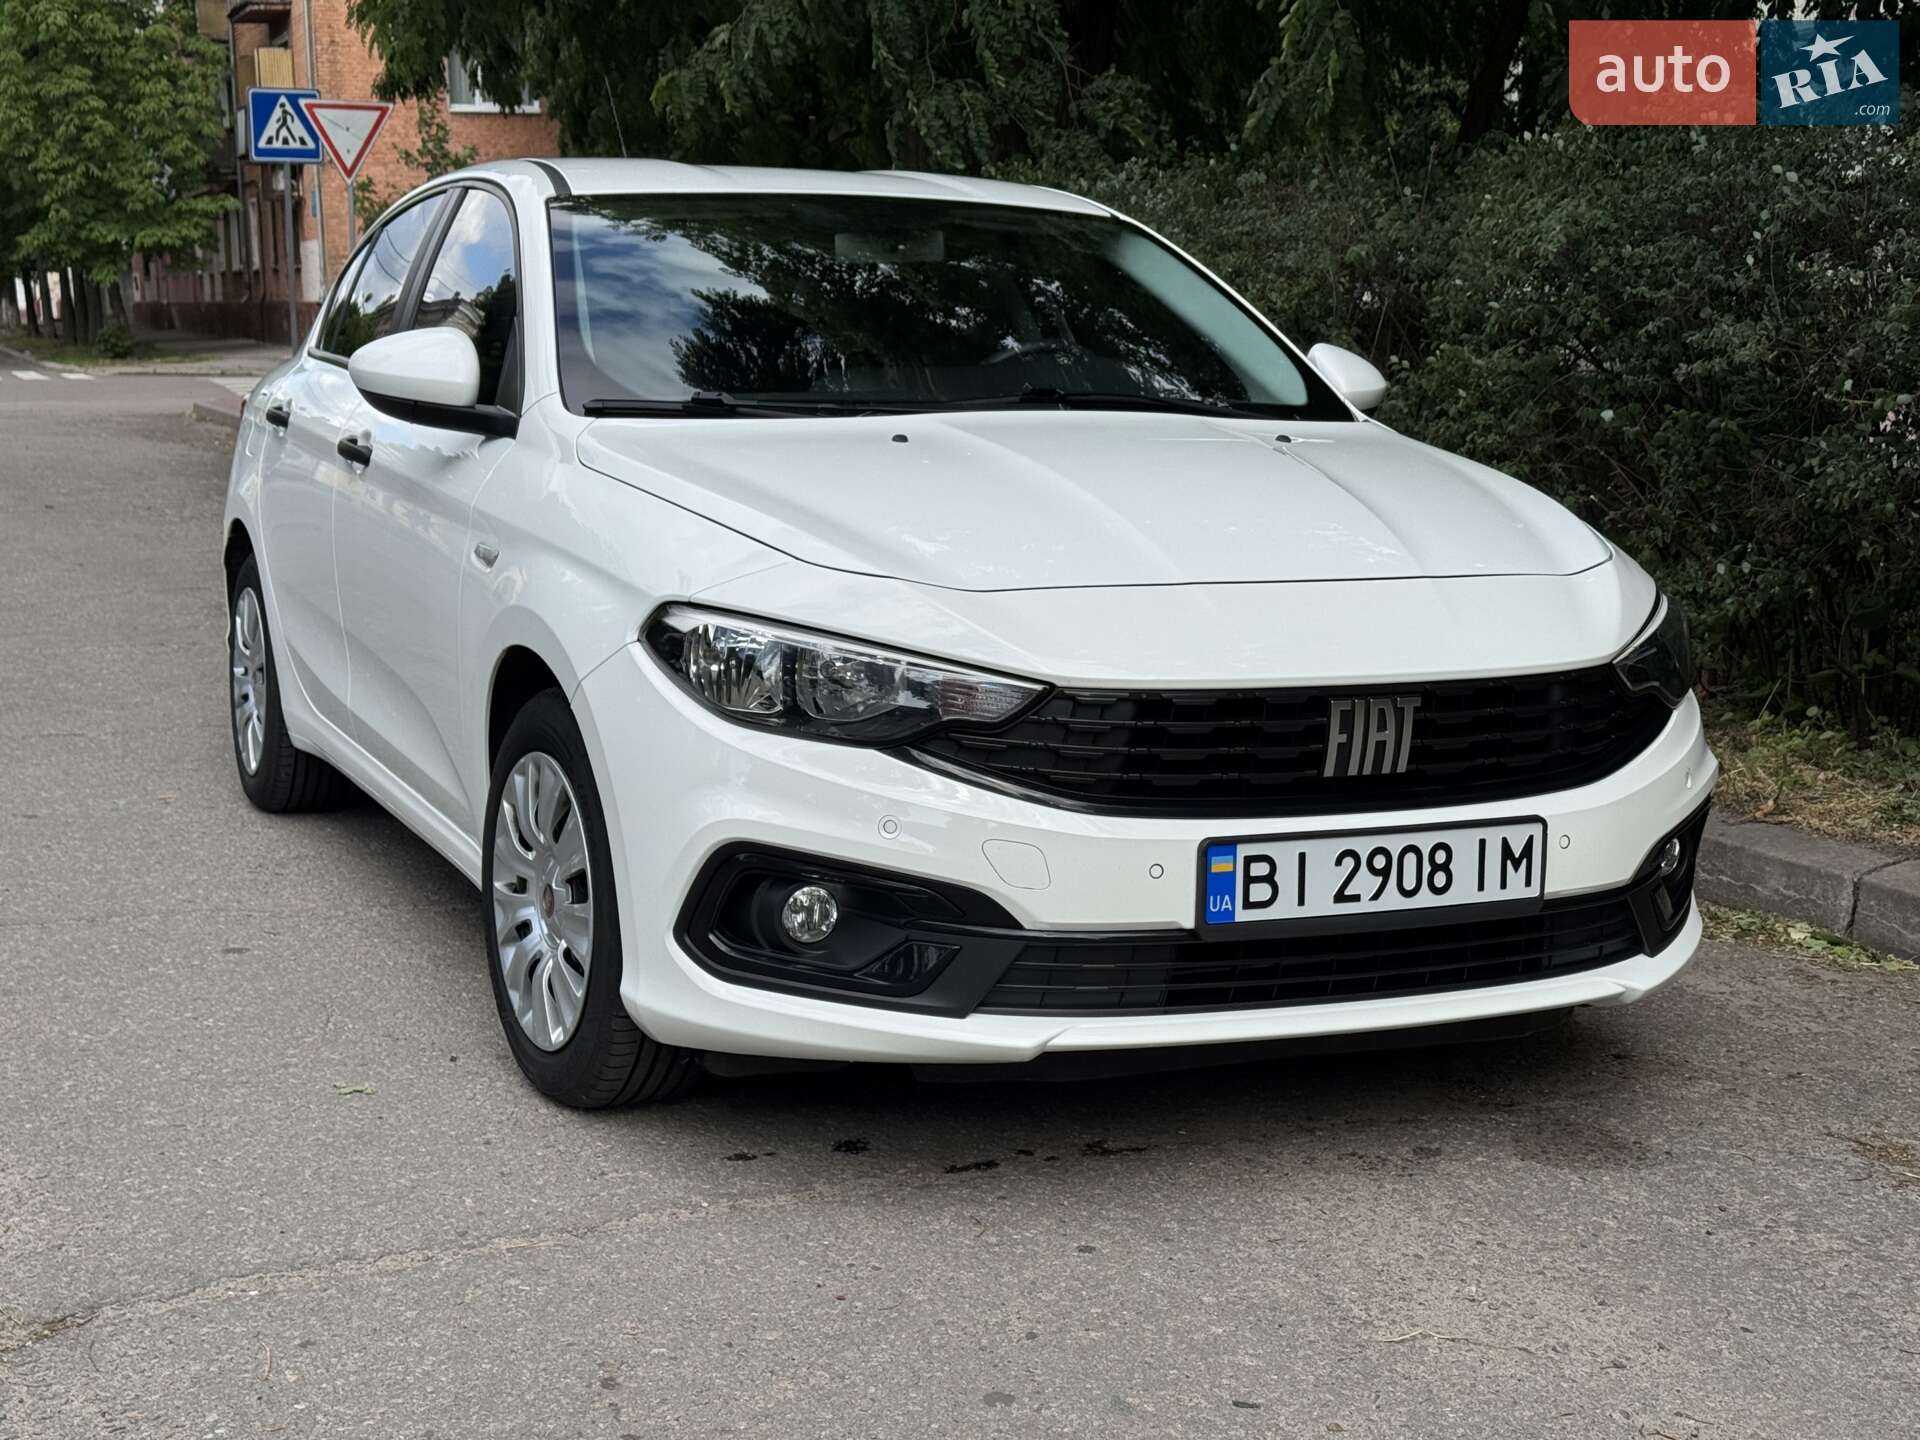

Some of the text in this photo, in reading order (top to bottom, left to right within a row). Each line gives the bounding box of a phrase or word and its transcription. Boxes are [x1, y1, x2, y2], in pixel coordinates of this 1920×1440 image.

[1323, 697, 1422, 778] FIAT
[1209, 895, 1233, 913] UA
[1242, 834, 1535, 911] BI 2908 IM
